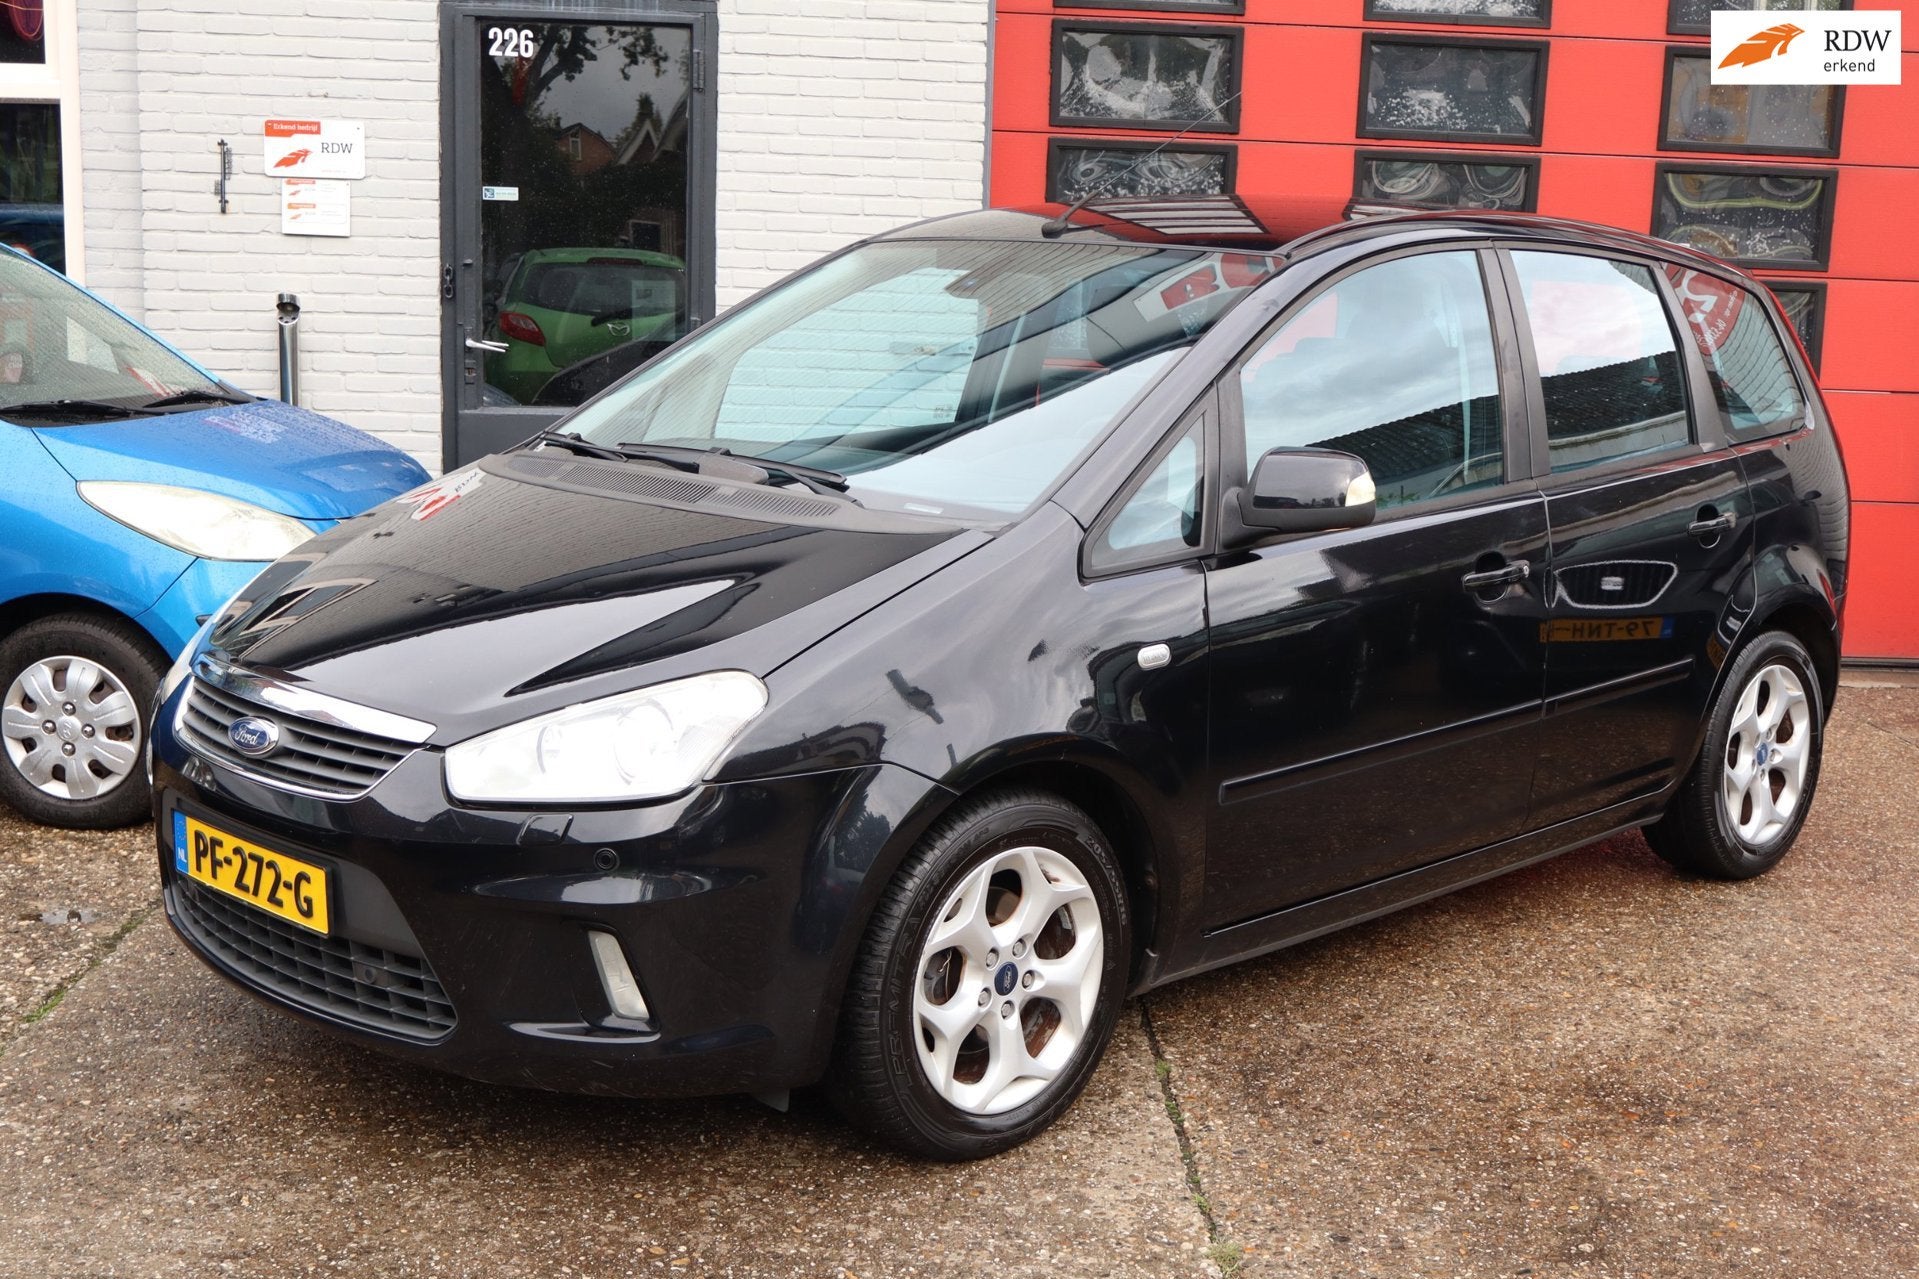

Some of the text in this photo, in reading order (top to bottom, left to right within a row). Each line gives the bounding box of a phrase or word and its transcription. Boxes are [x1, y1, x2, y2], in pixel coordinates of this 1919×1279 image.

[488, 27, 534, 58] 226
[273, 122, 319, 133] Erkend bedrijf
[321, 142, 353, 154] RDW
[234, 723, 259, 746] Ford
[176, 846, 188, 865] NL
[193, 828, 314, 920] PF-272-G
